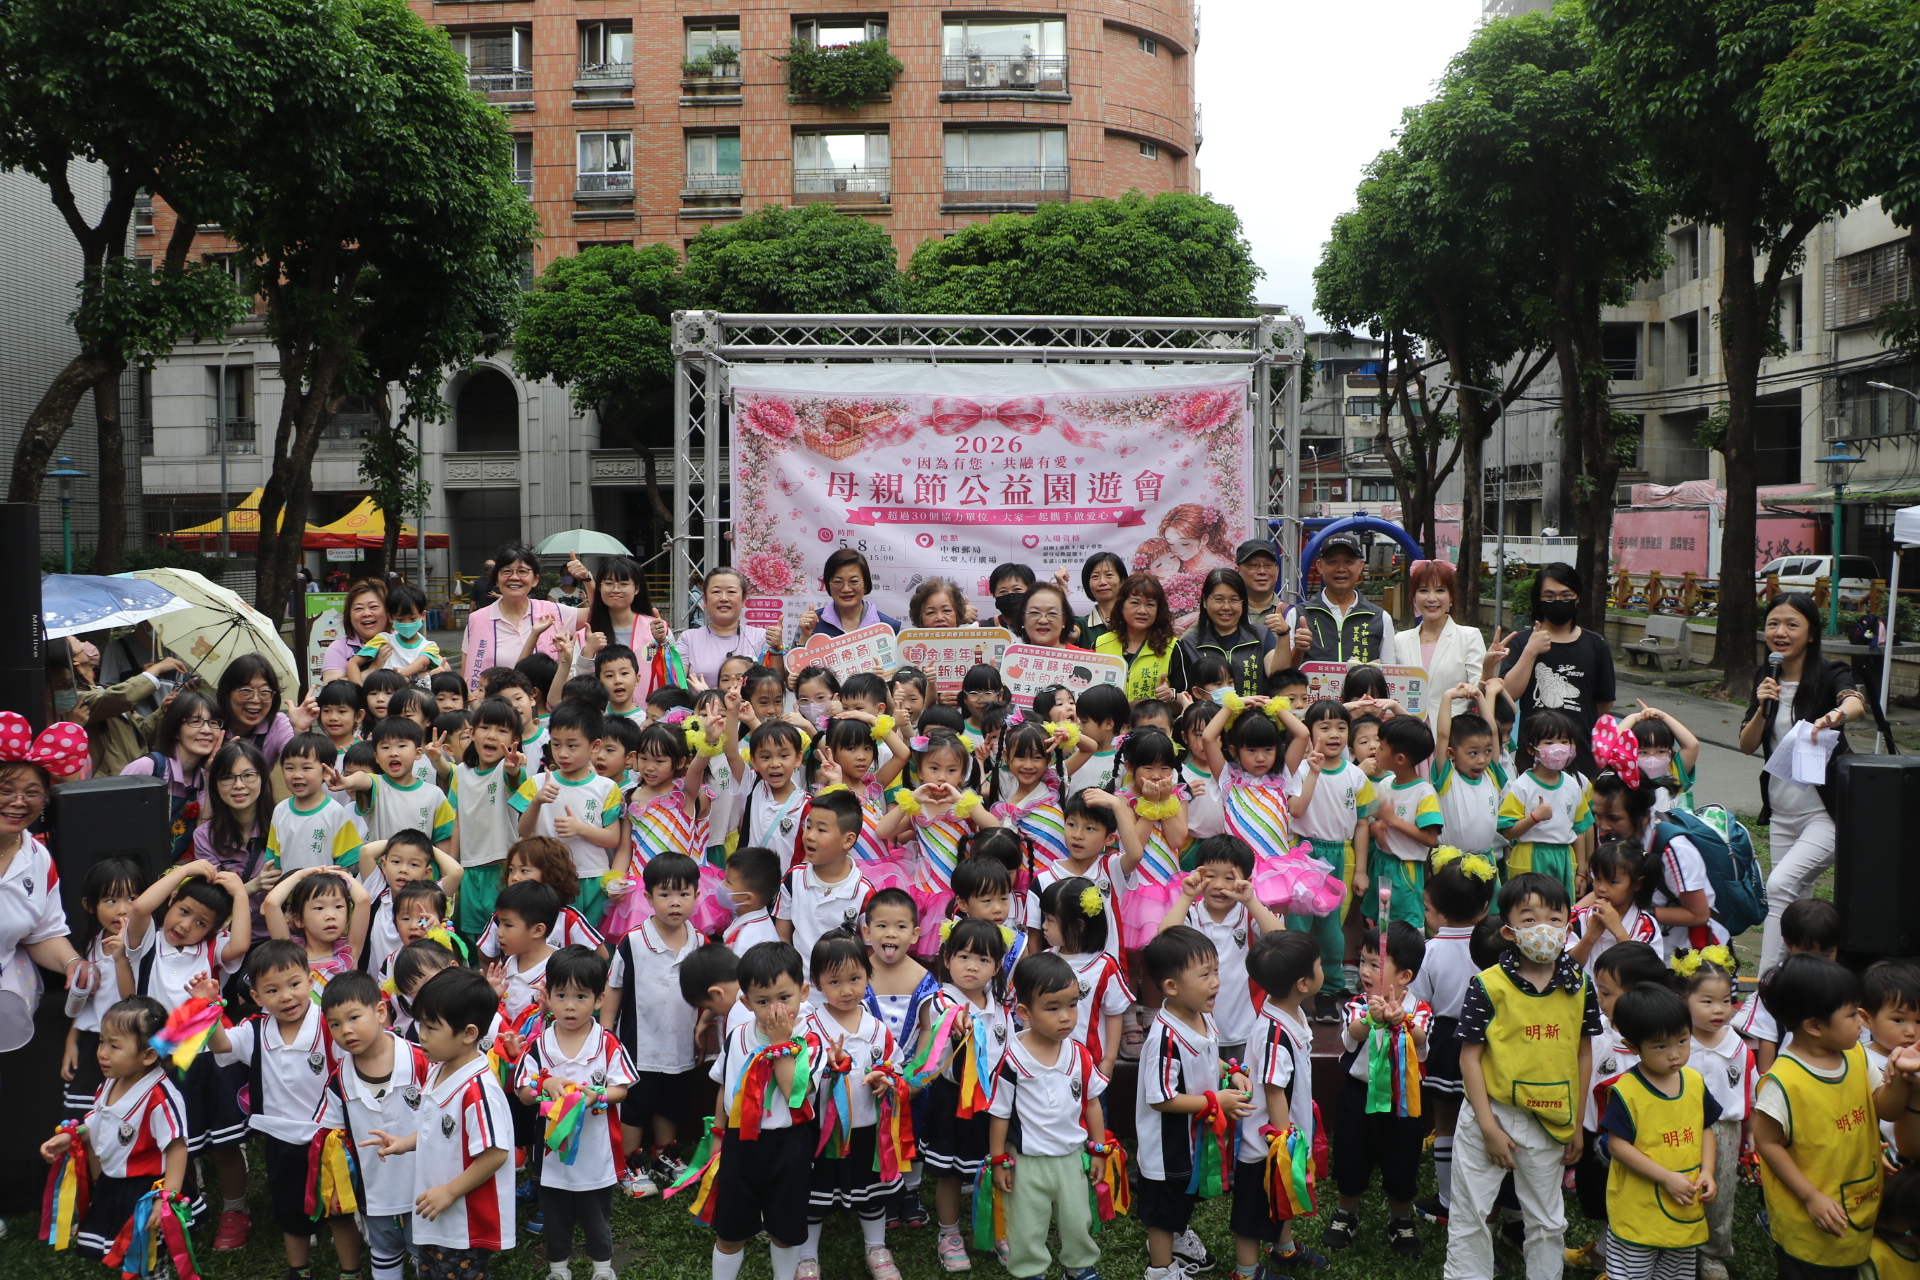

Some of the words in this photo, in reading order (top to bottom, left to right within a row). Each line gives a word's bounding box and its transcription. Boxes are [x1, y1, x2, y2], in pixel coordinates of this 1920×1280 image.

[955, 435, 1023, 454] 2026
[917, 455, 1068, 470] 因為有您，共融有愛
[825, 469, 1166, 507] 母親節公益園遊會
[837, 529, 855, 537] 時間
[940, 534, 959, 542] 地點
[1043, 534, 1081, 543] 入場資格
[940, 545, 981, 554] 中和郵局
[910, 647, 973, 661] 黃金童年
[1018, 656, 1074, 675] 發展篩檢
[719, 766, 730, 790] 勝利
[583, 798, 598, 824] 勝利
[309, 828, 326, 853] 勝利
[1525, 1023, 1561, 1041] 明新
[1526, 1099, 1563, 1109] 22473769
[1836, 1106, 1867, 1133] 明新
[1662, 1126, 1695, 1147] 明新
